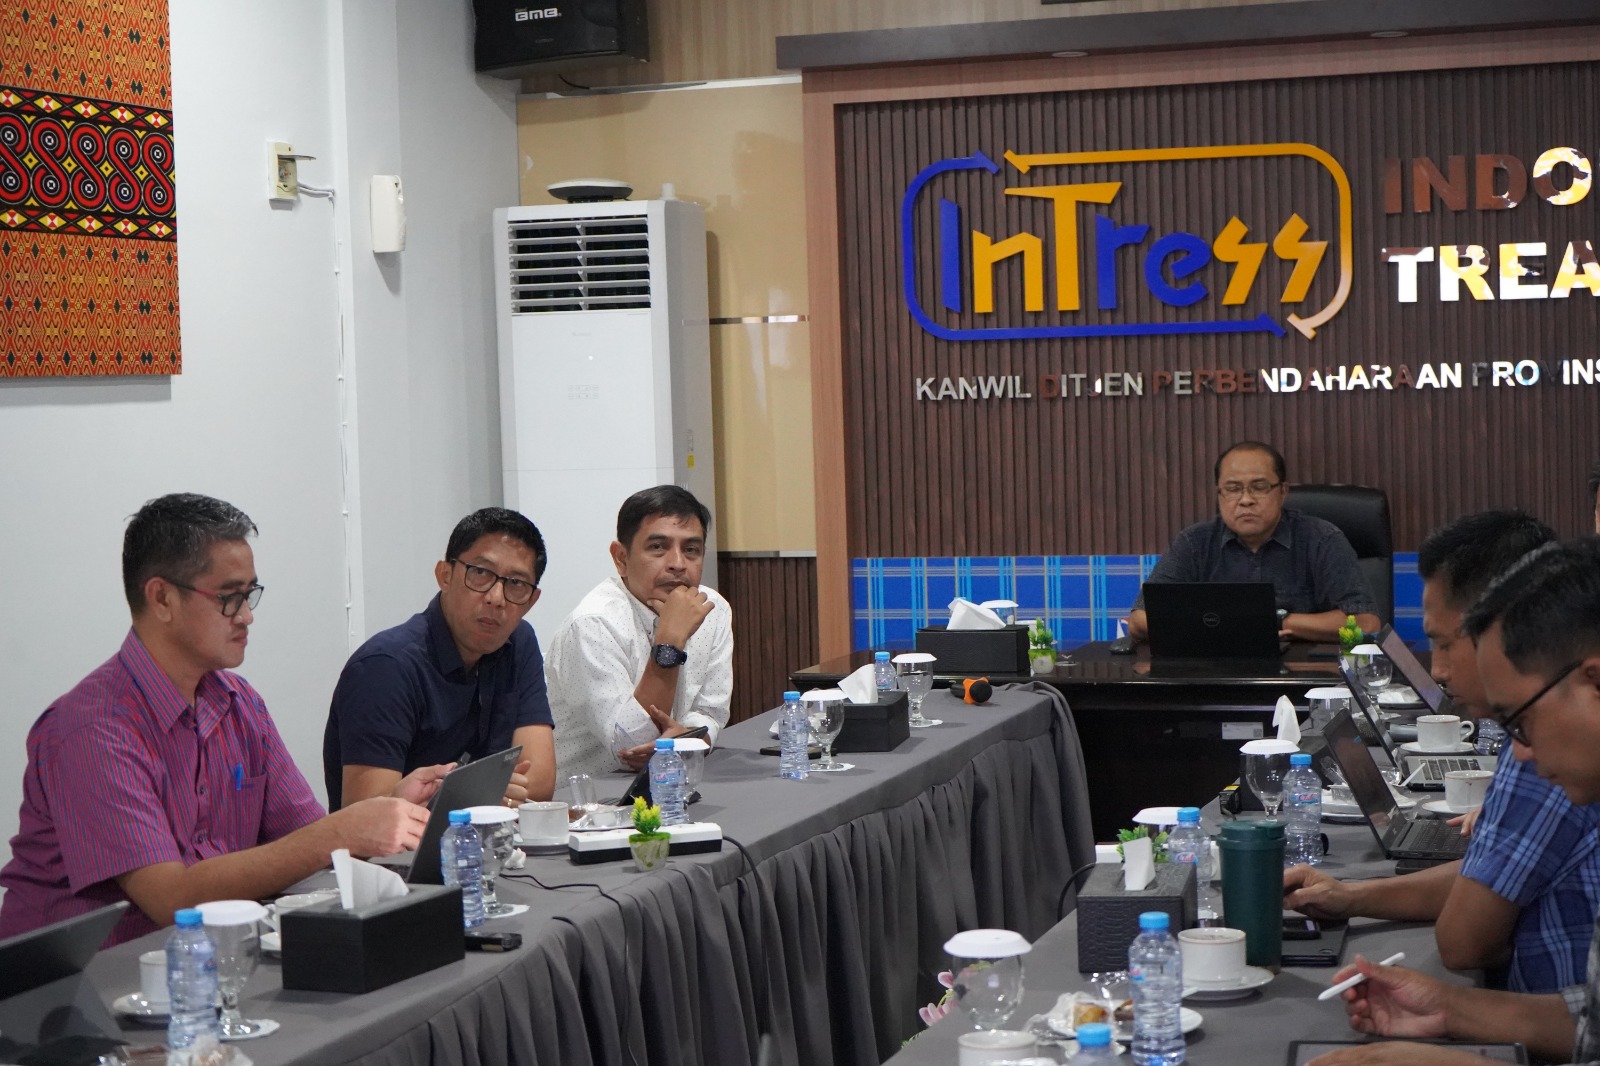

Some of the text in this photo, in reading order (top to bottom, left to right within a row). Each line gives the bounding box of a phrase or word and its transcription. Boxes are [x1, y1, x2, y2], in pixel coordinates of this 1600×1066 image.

[916, 374, 1032, 400] KANWIL
[1040, 372, 1143, 398] DITJEN
[1153, 361, 1462, 394] PERBENDAHARAAN
